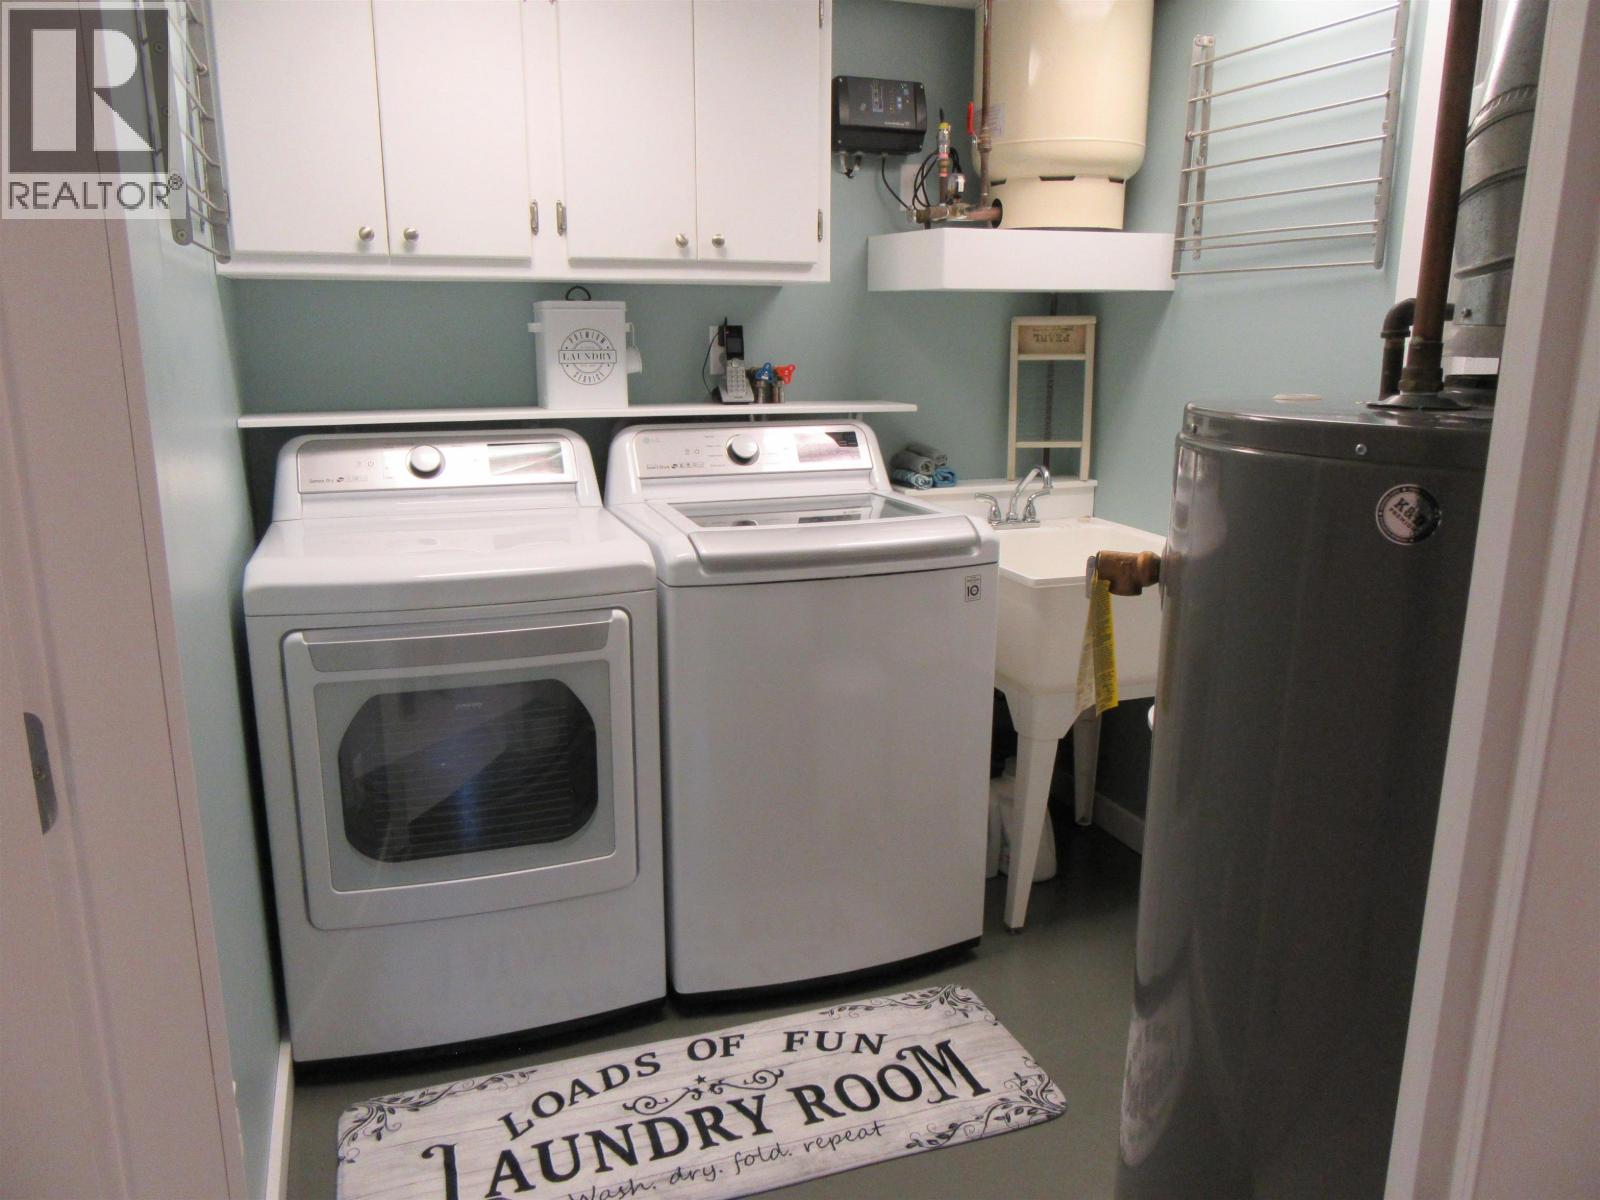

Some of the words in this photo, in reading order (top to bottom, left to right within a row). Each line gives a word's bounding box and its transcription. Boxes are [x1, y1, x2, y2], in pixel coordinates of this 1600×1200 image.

[563, 353, 612, 361] LAUNDRY
[569, 332, 607, 344] PREMIUM
[573, 371, 605, 383] SERVICE
[497, 1051, 662, 1141] LOADS
[686, 1033, 745, 1062] OF
[781, 1030, 888, 1055] FUN
[786, 1038, 993, 1126] ROOM
[669, 1165, 724, 1185] dry.
[734, 1142, 793, 1175] fold.
[803, 1120, 887, 1153] repeat
